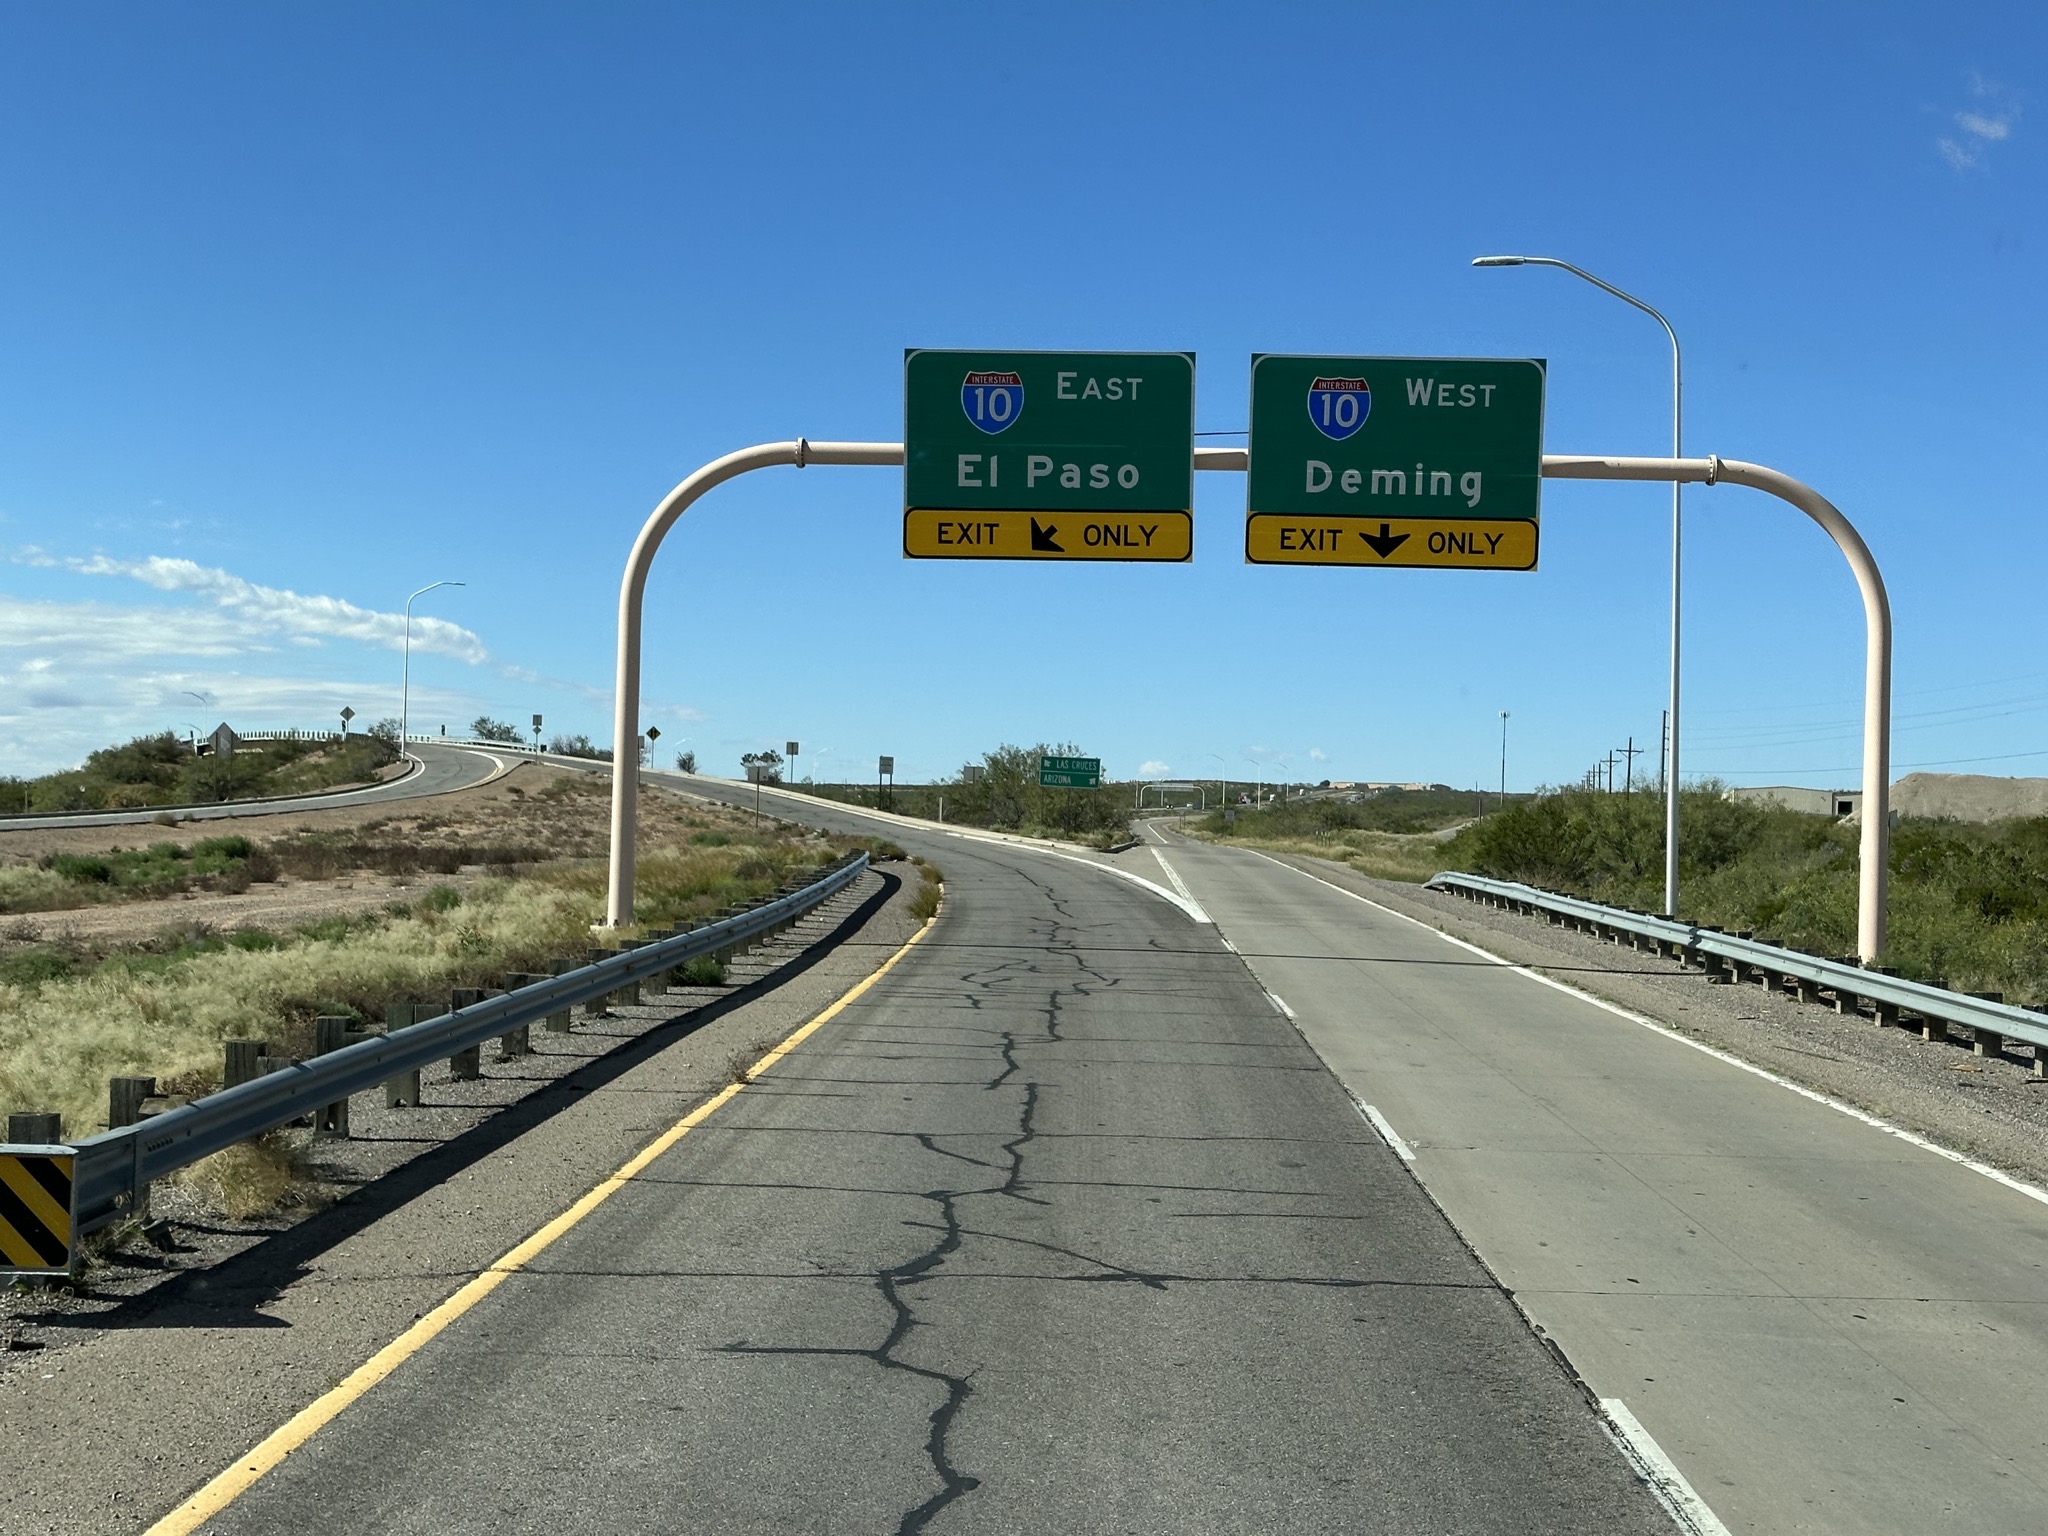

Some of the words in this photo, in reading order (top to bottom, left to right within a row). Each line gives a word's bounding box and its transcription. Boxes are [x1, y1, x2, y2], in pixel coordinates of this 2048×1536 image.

[972, 375, 1014, 385] INTERSTATE
[1057, 371, 1143, 401] EAST
[1319, 381, 1361, 391] INTERSTATE
[1406, 378, 1496, 408] WEST
[975, 387, 1012, 422] 10
[1321, 393, 1359, 428] 10
[958, 454, 998, 487] El
[1027, 455, 1140, 489] Paso
[1306, 460, 1482, 508] Deming
[937, 522, 1000, 545] EXIT
[1083, 524, 1159, 547] ONLY
[1280, 528, 1343, 551] EXIT
[1428, 531, 1504, 555] ONLY
[1043, 774, 1072, 784] ARIZONA
[1056, 760, 1069, 769] LAS
[1072, 761, 1097, 771] CRUCES
